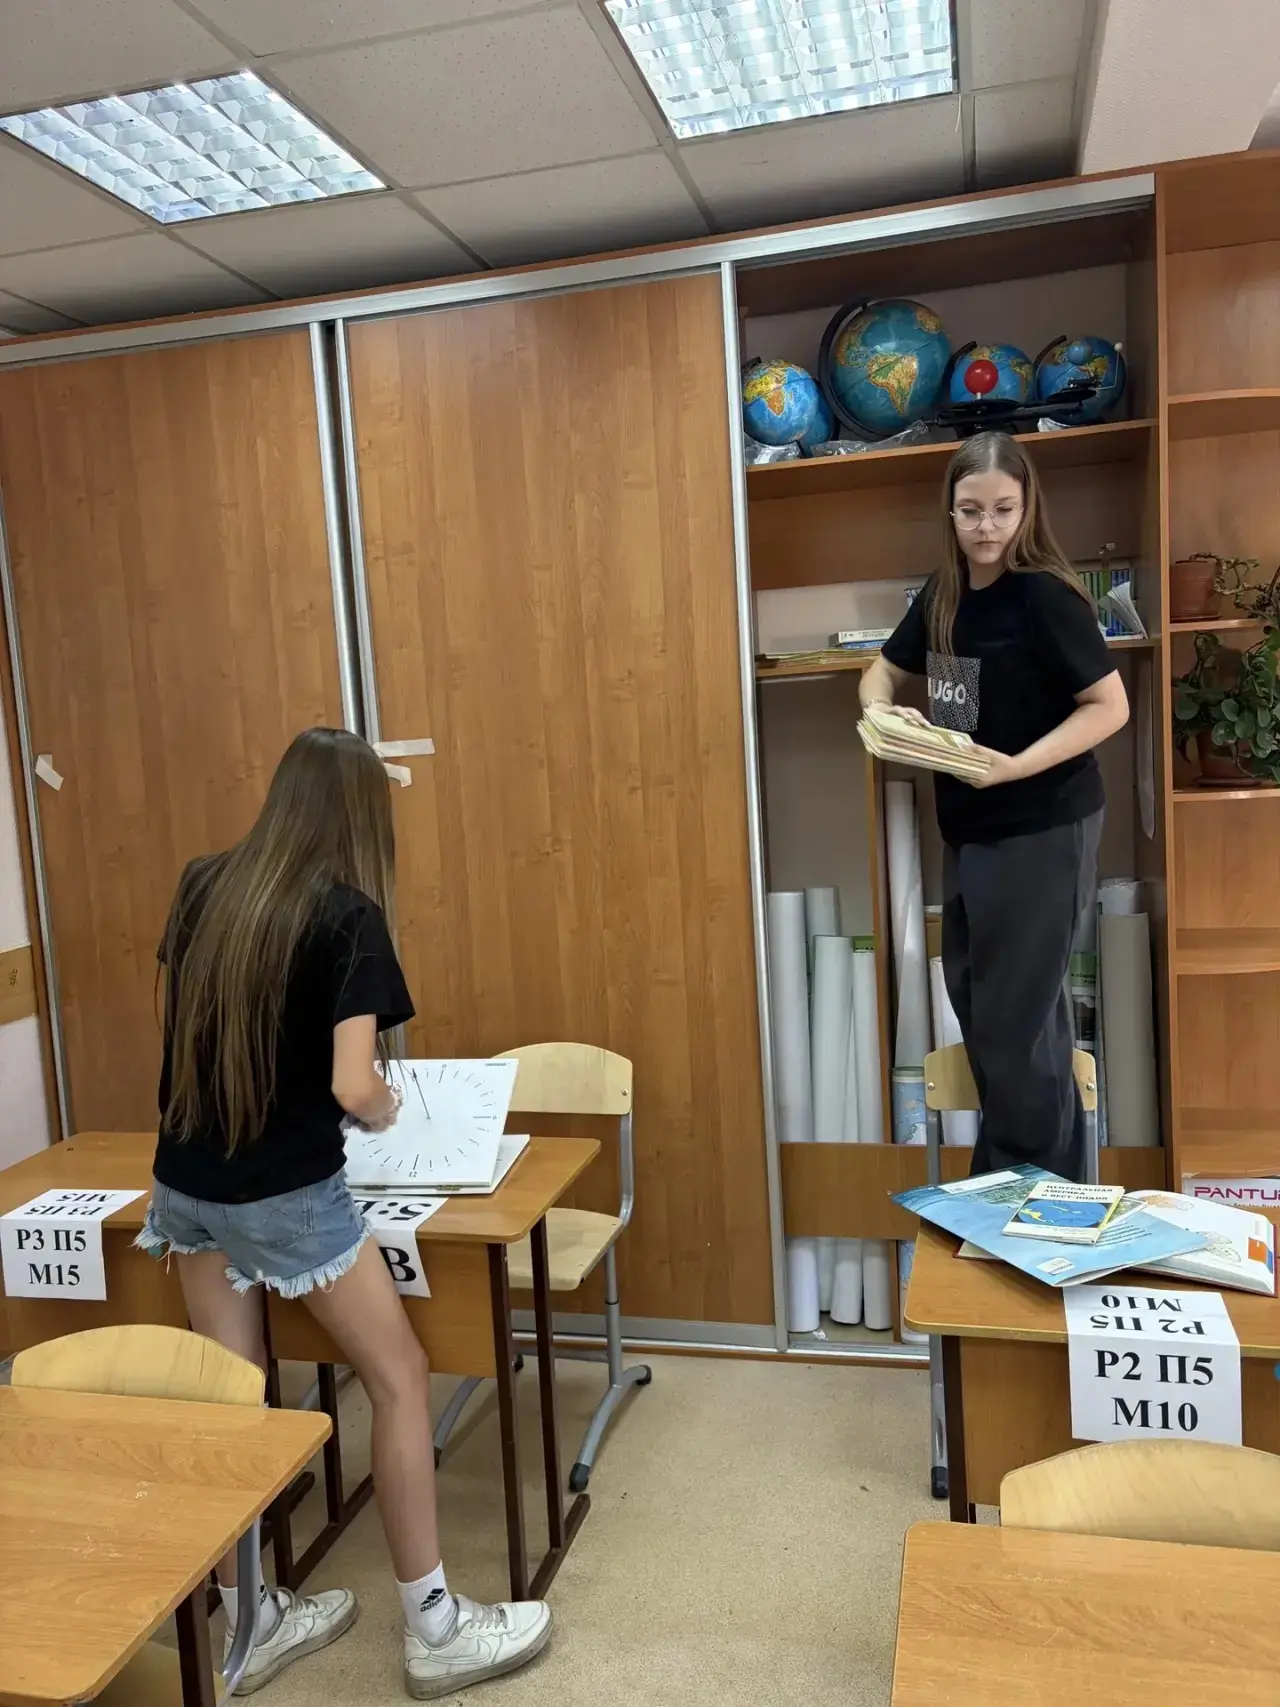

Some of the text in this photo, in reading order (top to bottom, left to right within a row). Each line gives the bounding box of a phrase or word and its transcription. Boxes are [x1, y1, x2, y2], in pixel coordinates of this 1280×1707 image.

[1194, 1186, 1280, 1200] PANTU
[15, 1229, 87, 1252] Р3 П5
[28, 1263, 81, 1286] М15
[1101, 1294, 1183, 1312] М10
[1090, 1315, 1147, 1332] П5
[1094, 1350, 1214, 1386] Р2 П5
[1111, 1397, 1199, 1432] М10
[419, 1591, 446, 1612] adidas
